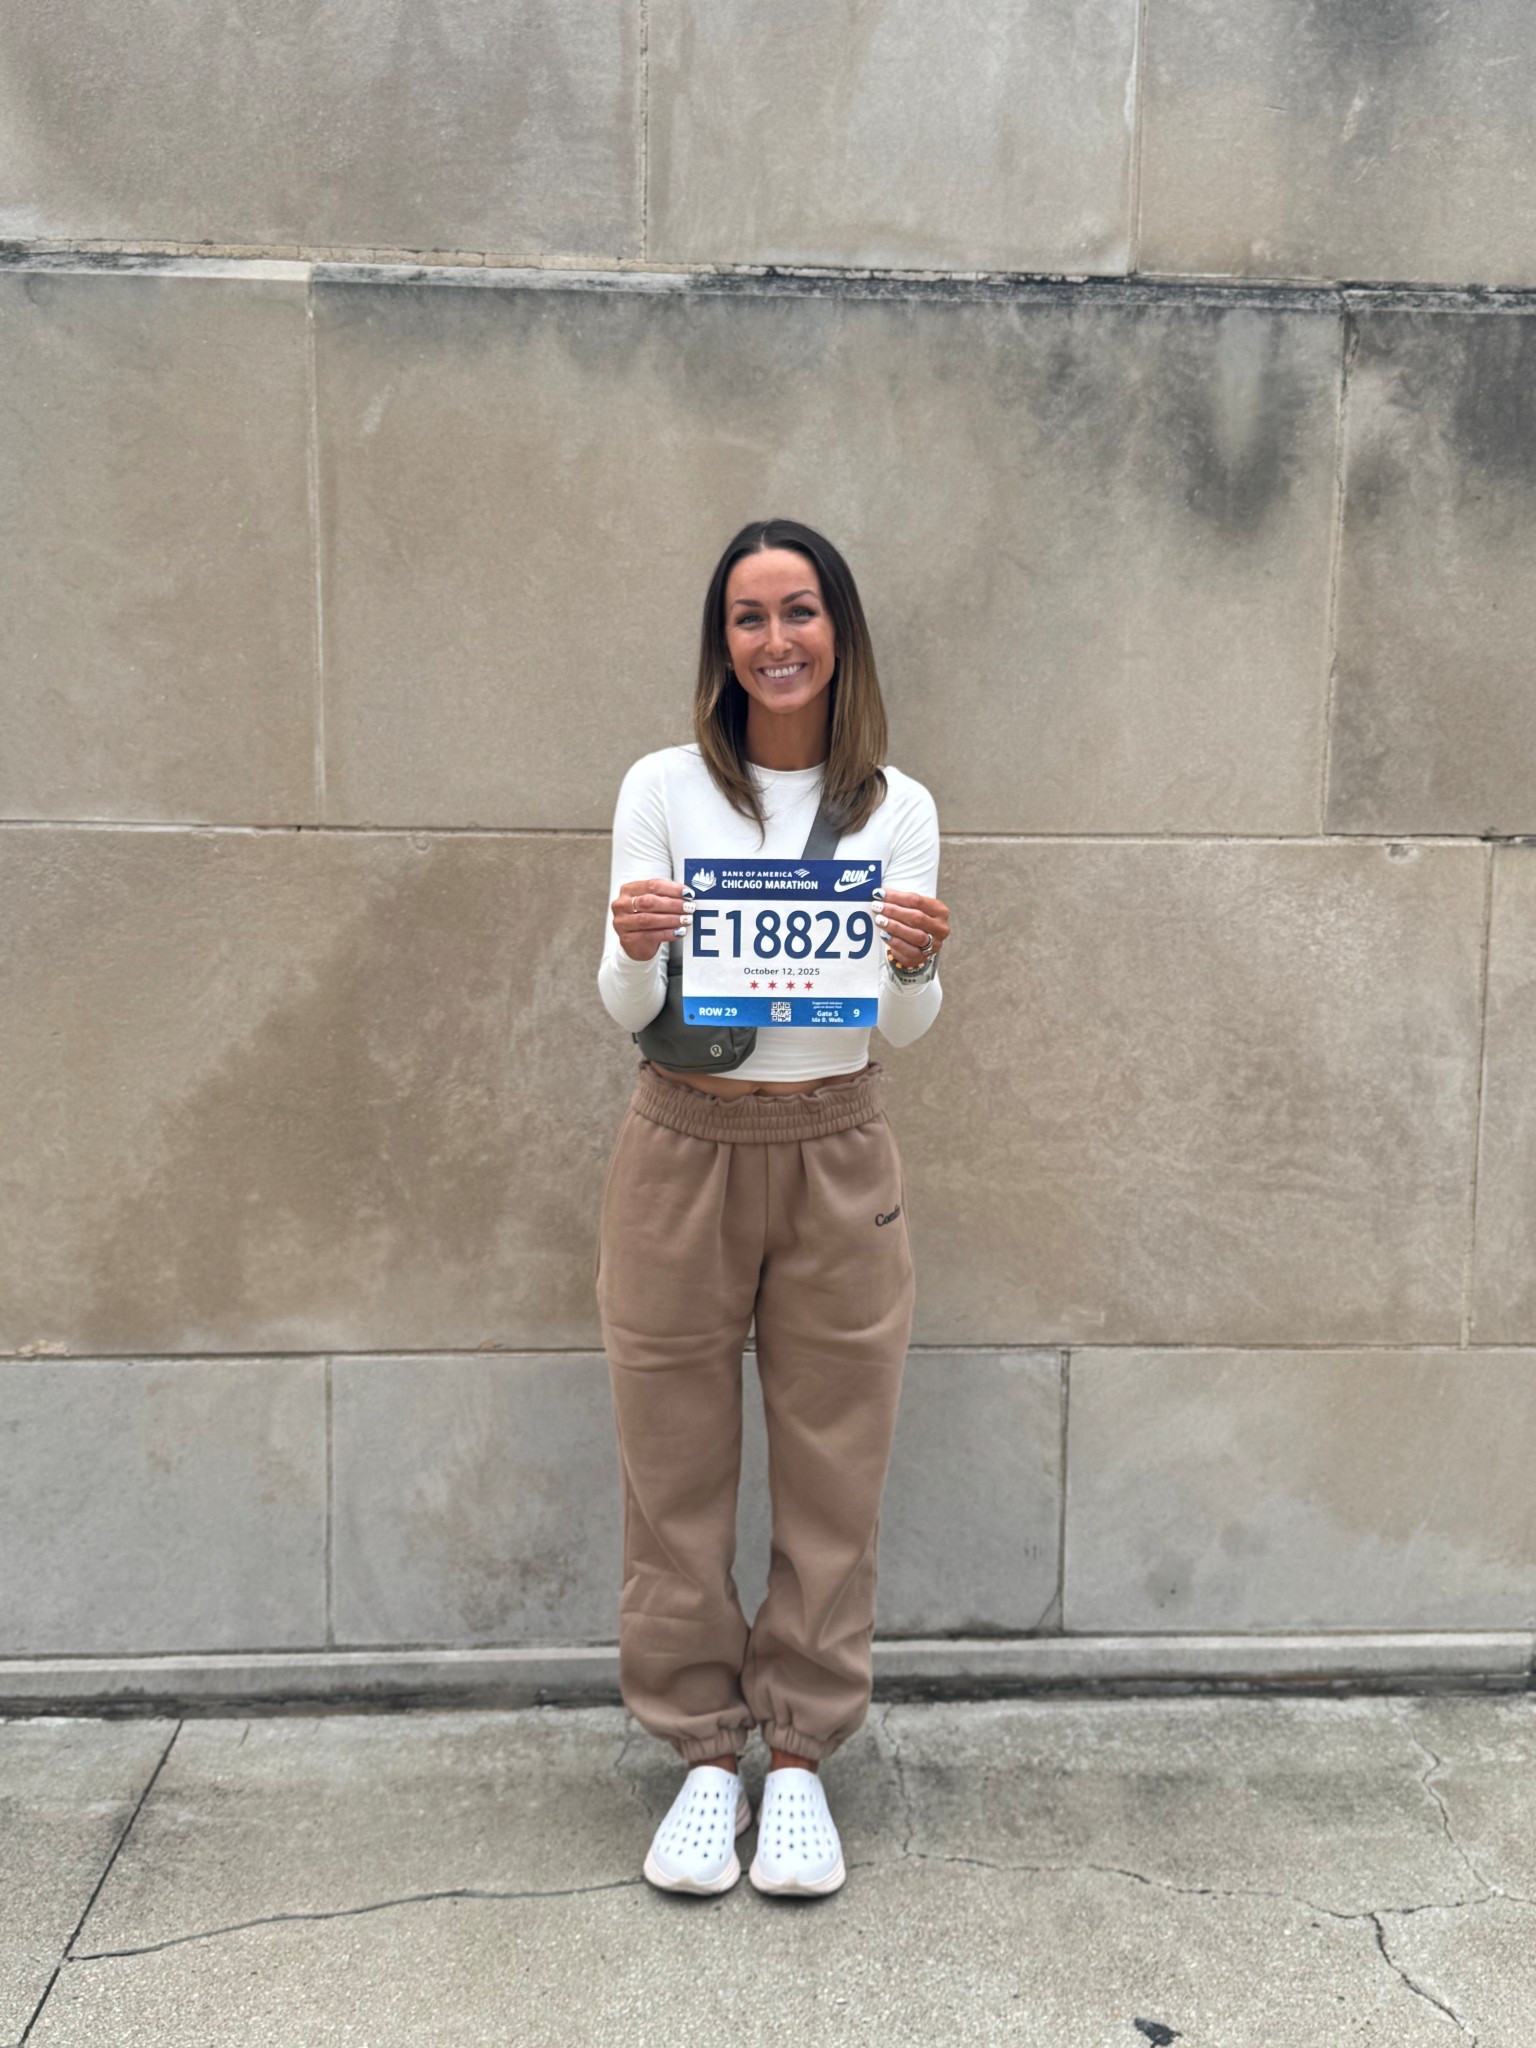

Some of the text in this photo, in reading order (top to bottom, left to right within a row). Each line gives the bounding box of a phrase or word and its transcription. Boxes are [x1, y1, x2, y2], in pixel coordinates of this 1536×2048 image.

[840, 869, 869, 883] RUN
[721, 880, 818, 890] CHICAGO MARATHON
[692, 909, 874, 960] E18829
[743, 967, 820, 976] October 12, 2025
[699, 1007, 738, 1017] ROW 29
[853, 1008, 861, 1018] 9
